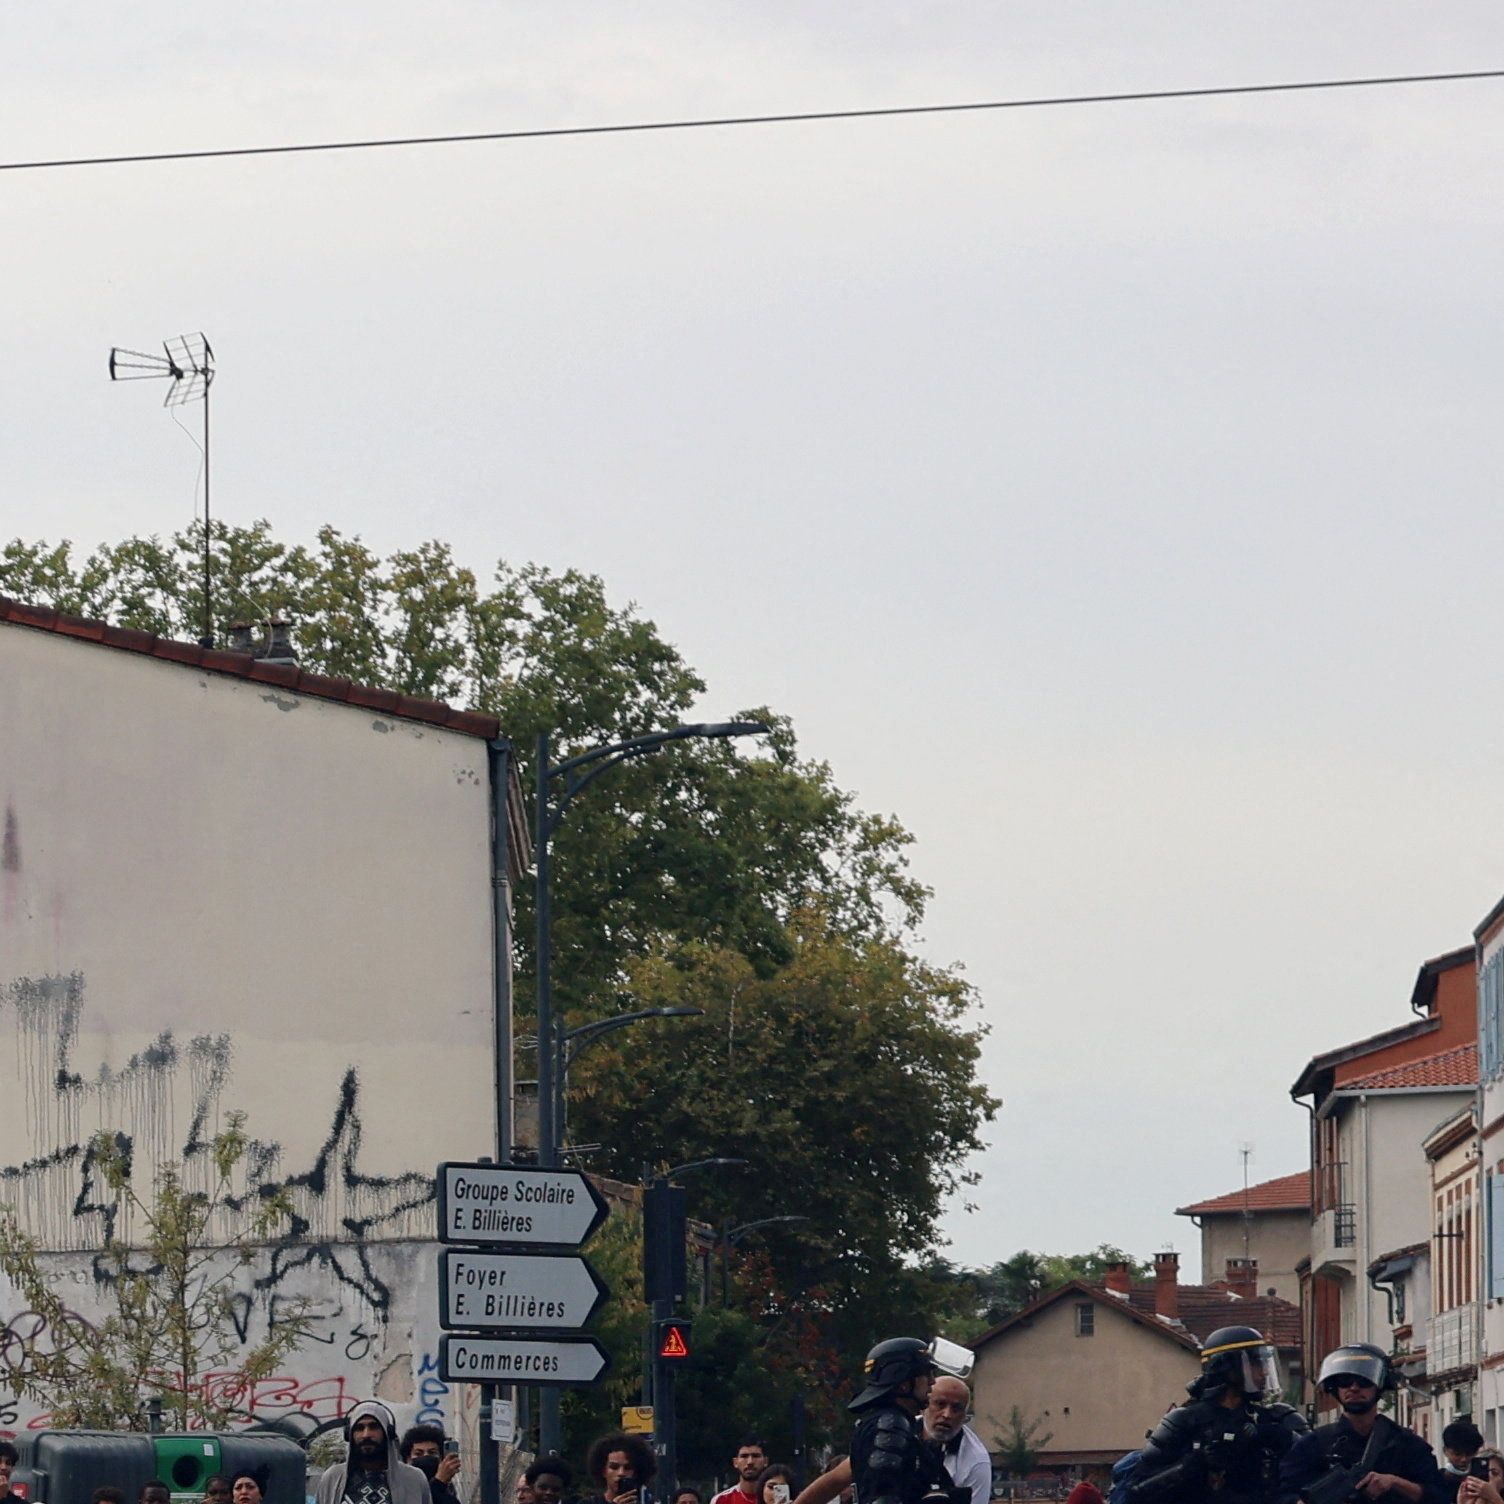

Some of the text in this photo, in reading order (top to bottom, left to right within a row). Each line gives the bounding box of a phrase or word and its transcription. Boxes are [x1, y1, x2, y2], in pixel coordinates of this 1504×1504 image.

[454, 1177, 575, 1205] Groupe Scolaire
[453, 1208, 533, 1233] E. Billières
[454, 1263, 507, 1290] Foyer
[455, 1294, 566, 1318] E. Billières
[455, 1347, 559, 1372] Commerces
